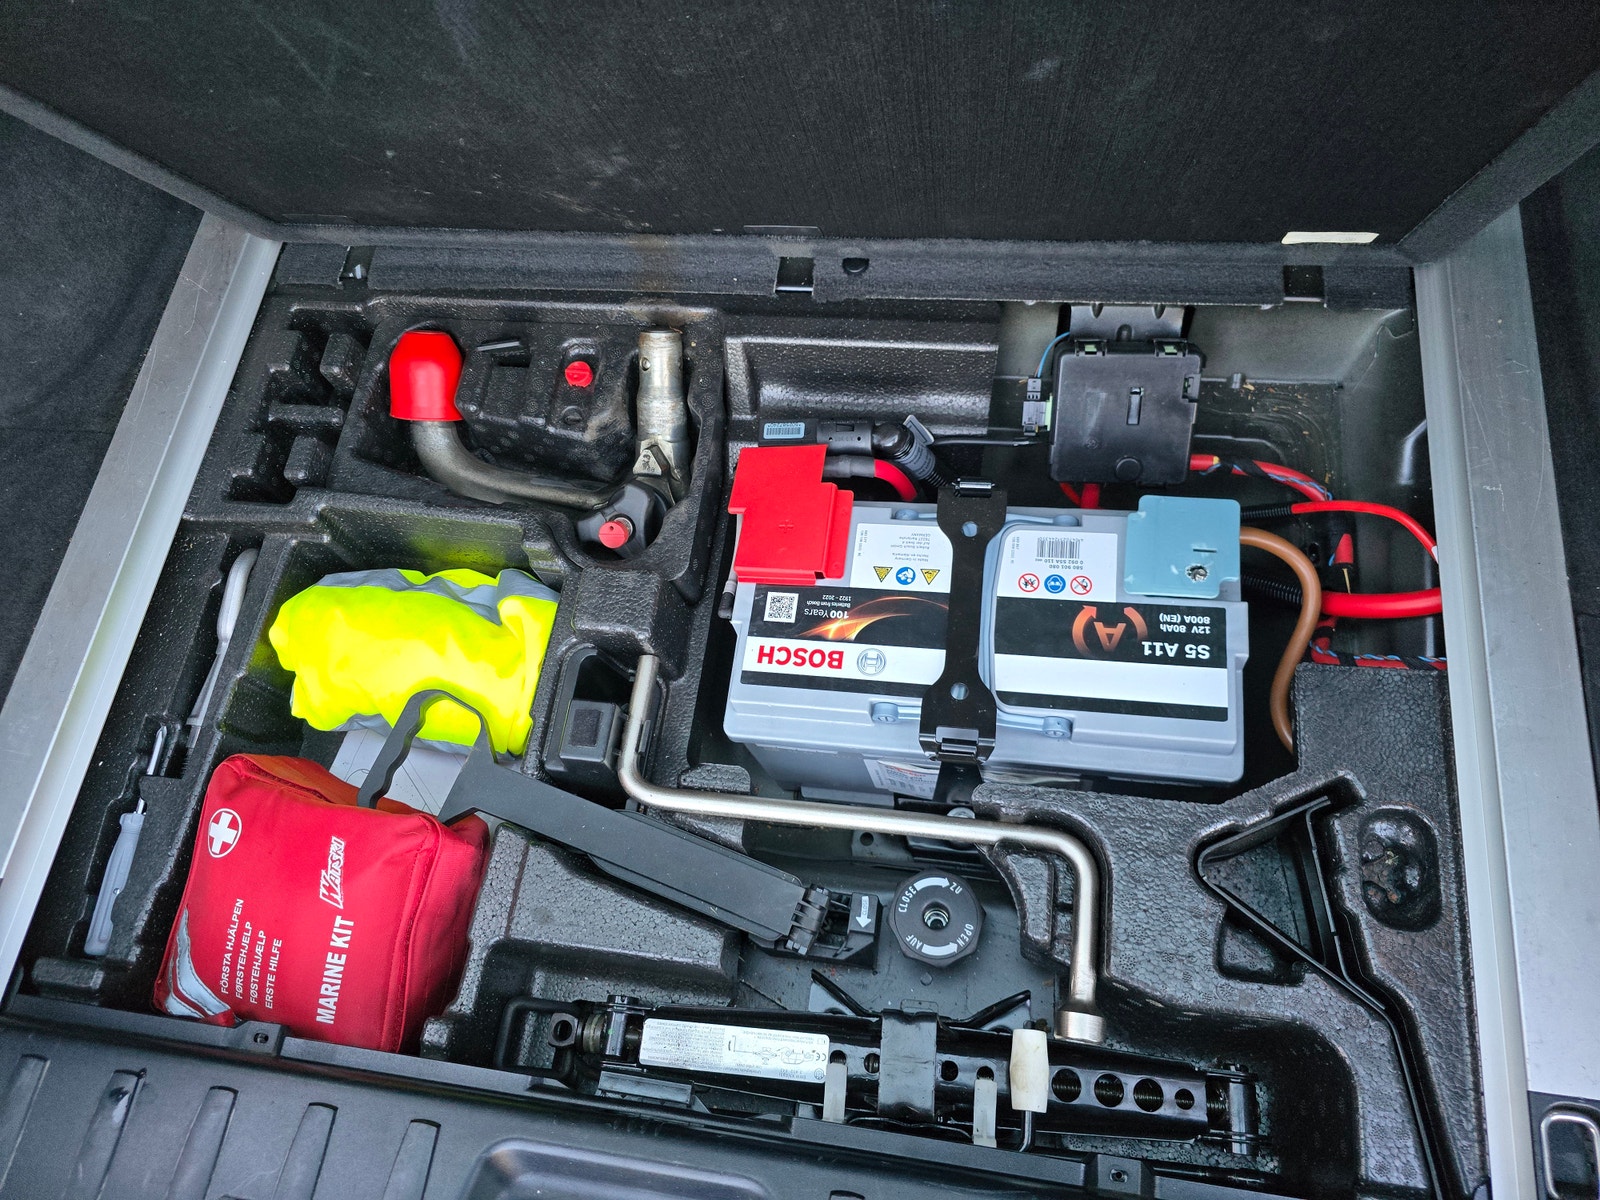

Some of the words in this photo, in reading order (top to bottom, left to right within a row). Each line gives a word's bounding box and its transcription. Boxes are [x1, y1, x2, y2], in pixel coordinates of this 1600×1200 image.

[804, 608, 829, 618] Years
[829, 610, 850, 620] 100
[1158, 612, 1182, 624] (EN)
[1184, 615, 1211, 625] 800A
[1160, 624, 1187, 634] 80Ah
[1191, 625, 1211, 635] 12V
[756, 644, 844, 670] BOSCH
[1140, 641, 1180, 658] A11
[1184, 644, 1211, 660] S5
[950, 882, 963, 894] ZU
[898, 886, 917, 913] CLOSE
[329, 914, 354, 949] KIT
[956, 923, 974, 947] OPEN
[220, 952, 234, 995] FÖRSTA
[227, 898, 244, 951] HJÄLPEN
[906, 934, 923, 950] AUF
[234, 921, 252, 1000] FØRSTEHJELP
[268, 938, 282, 972] HILFE
[249, 930, 267, 1005] FØSTEHJÆLP
[264, 973, 276, 1010] ERSTE
[316, 951, 348, 1025] MARINE
